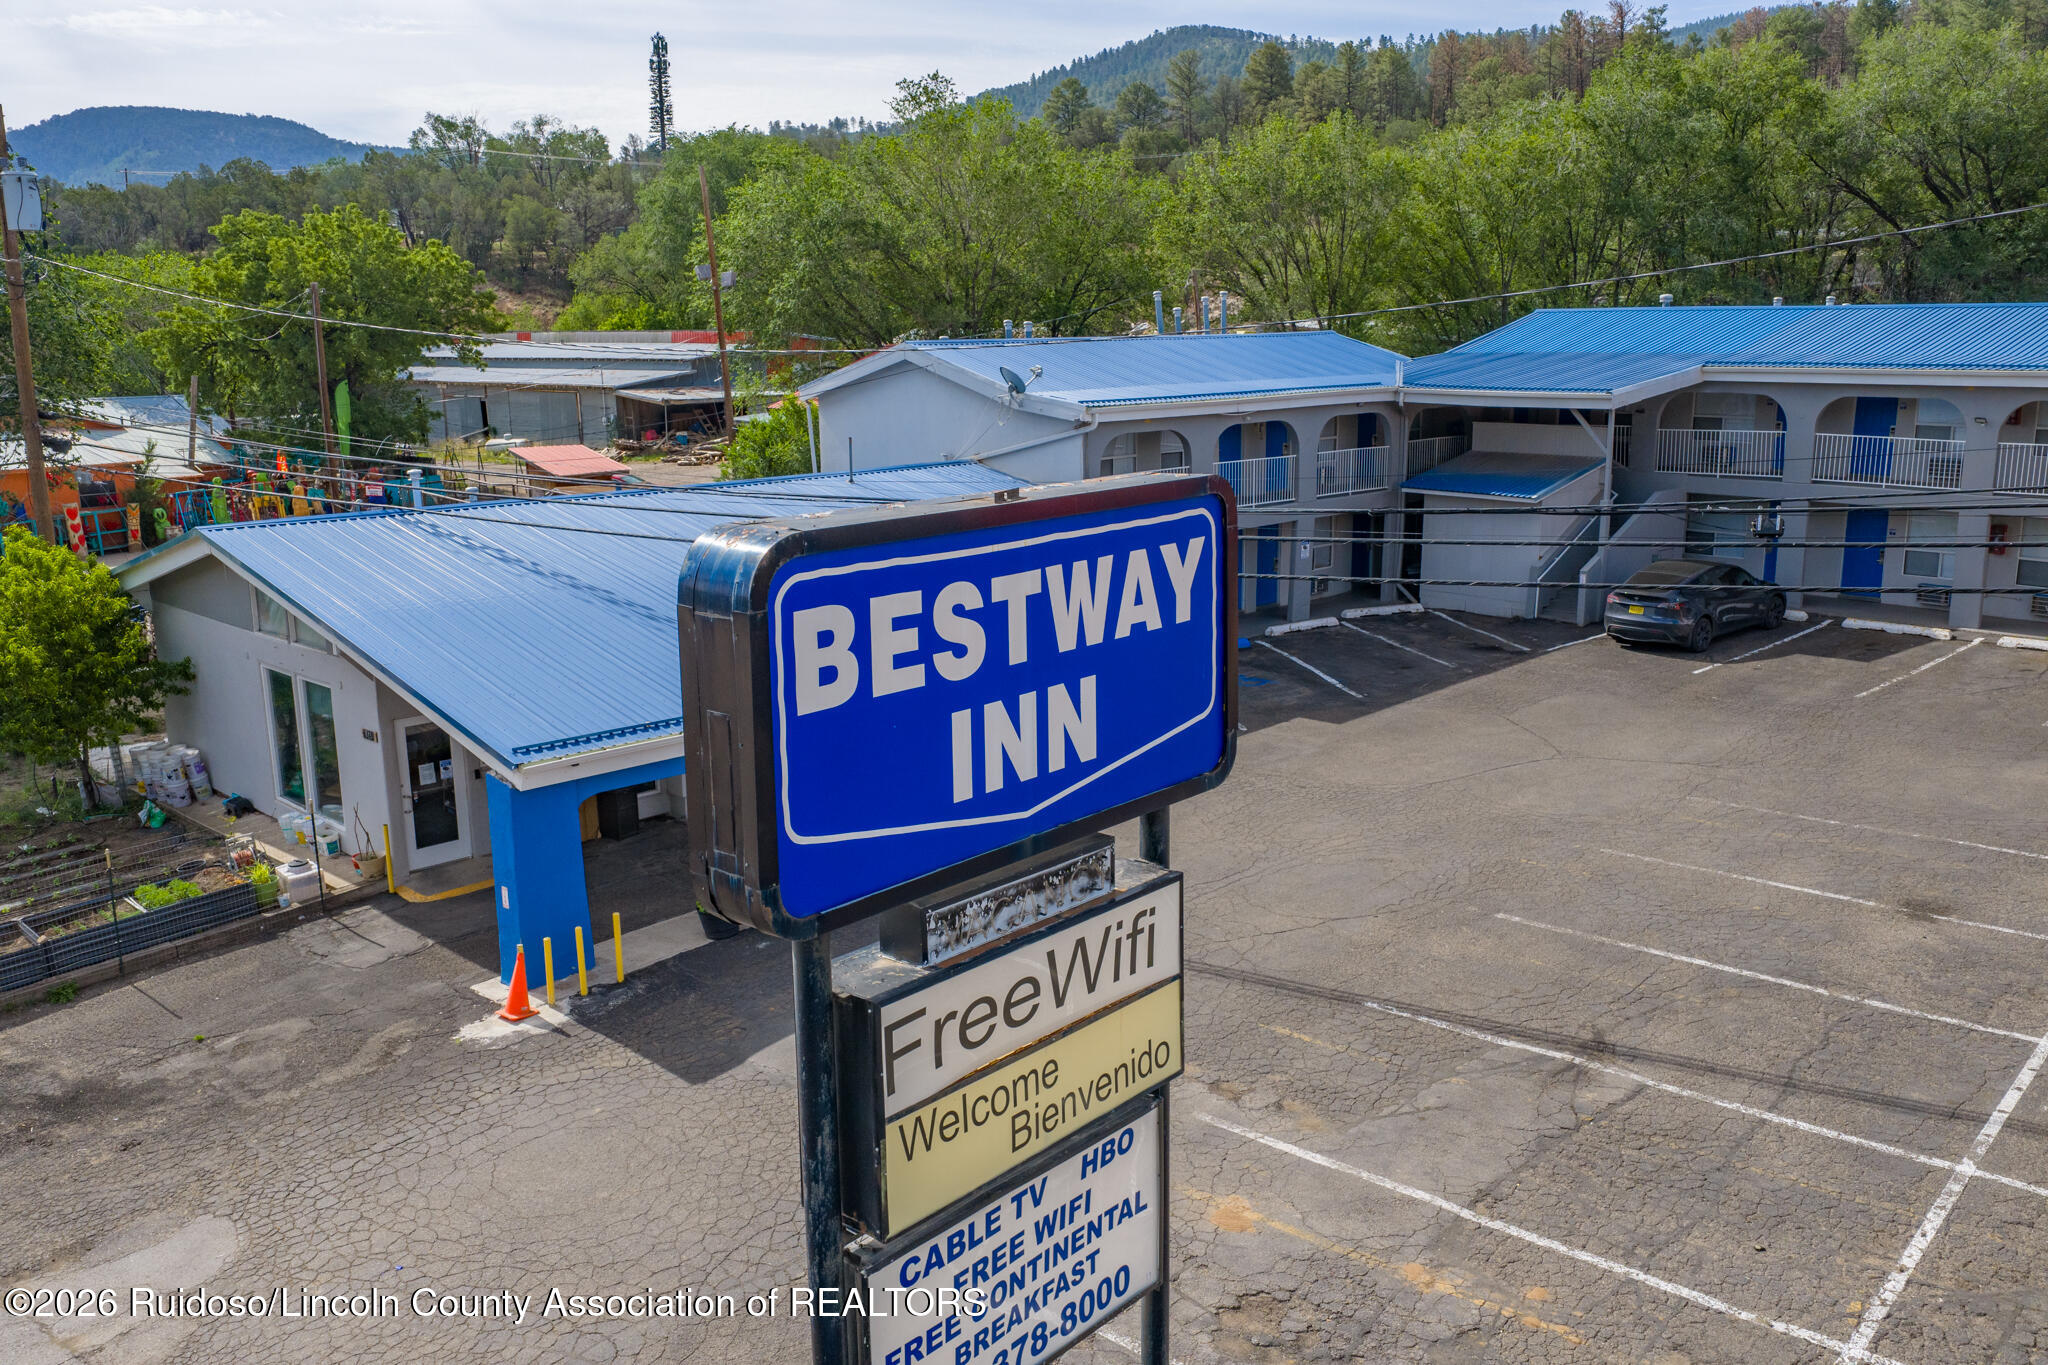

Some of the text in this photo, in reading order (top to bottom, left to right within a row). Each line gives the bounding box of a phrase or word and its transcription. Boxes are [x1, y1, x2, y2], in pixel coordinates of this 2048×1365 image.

[793, 535, 1205, 717] BESTWAY
[951, 674, 1098, 804] INN
[898, 1057, 1060, 1163] Welcome
[1010, 1038, 1171, 1155] Bienvenido
[898, 1127, 1135, 1289] CABLE TV HBO
[953, 1189, 1092, 1296] FREE WIFI
[971, 1189, 1149, 1324] CONTINENTAL
[954, 1248, 1101, 1365] BREAKFAST
